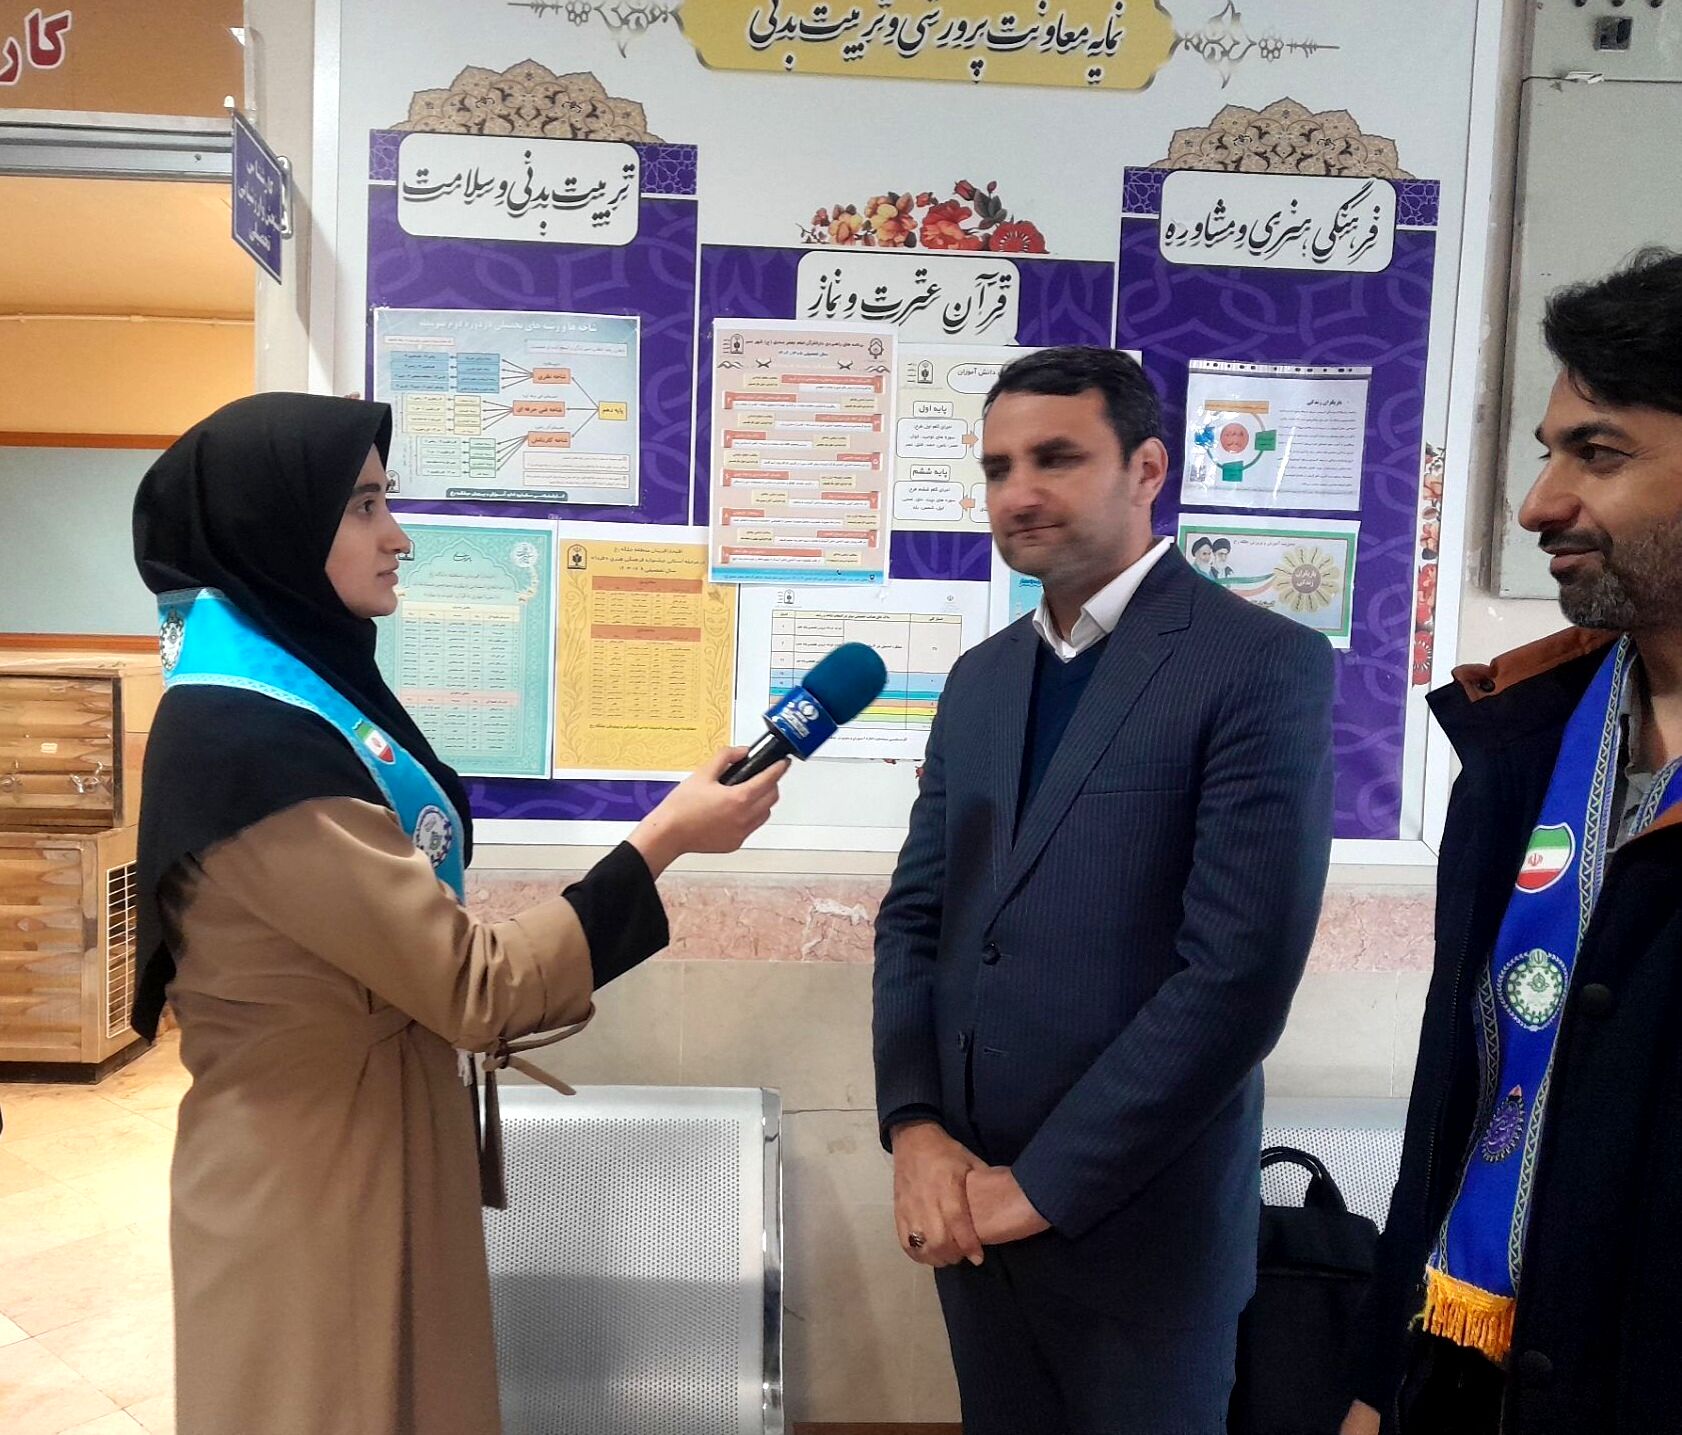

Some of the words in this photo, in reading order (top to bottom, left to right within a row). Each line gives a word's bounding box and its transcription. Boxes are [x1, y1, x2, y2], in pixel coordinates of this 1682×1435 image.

[800, 0, 891, 58] تربیت
[898, 0, 989, 80] پرورشی
[987, 0, 1088, 50] معاونت
[1087, 1, 1123, 81] نمایه
[402, 167, 495, 200] سلامت
[497, 179, 508, 200] و
[507, 150, 550, 231] بدنی
[552, 163, 635, 224] تربیت
[1164, 198, 1235, 243] مشاوره
[1234, 223, 1248, 243] و
[1249, 199, 1312, 254] هنری
[1312, 180, 1381, 259] فرهنگی
[807, 268, 842, 316] نماز
[844, 292, 857, 314] و
[861, 268, 942, 324] عترت
[942, 271, 1012, 330] قرآن
